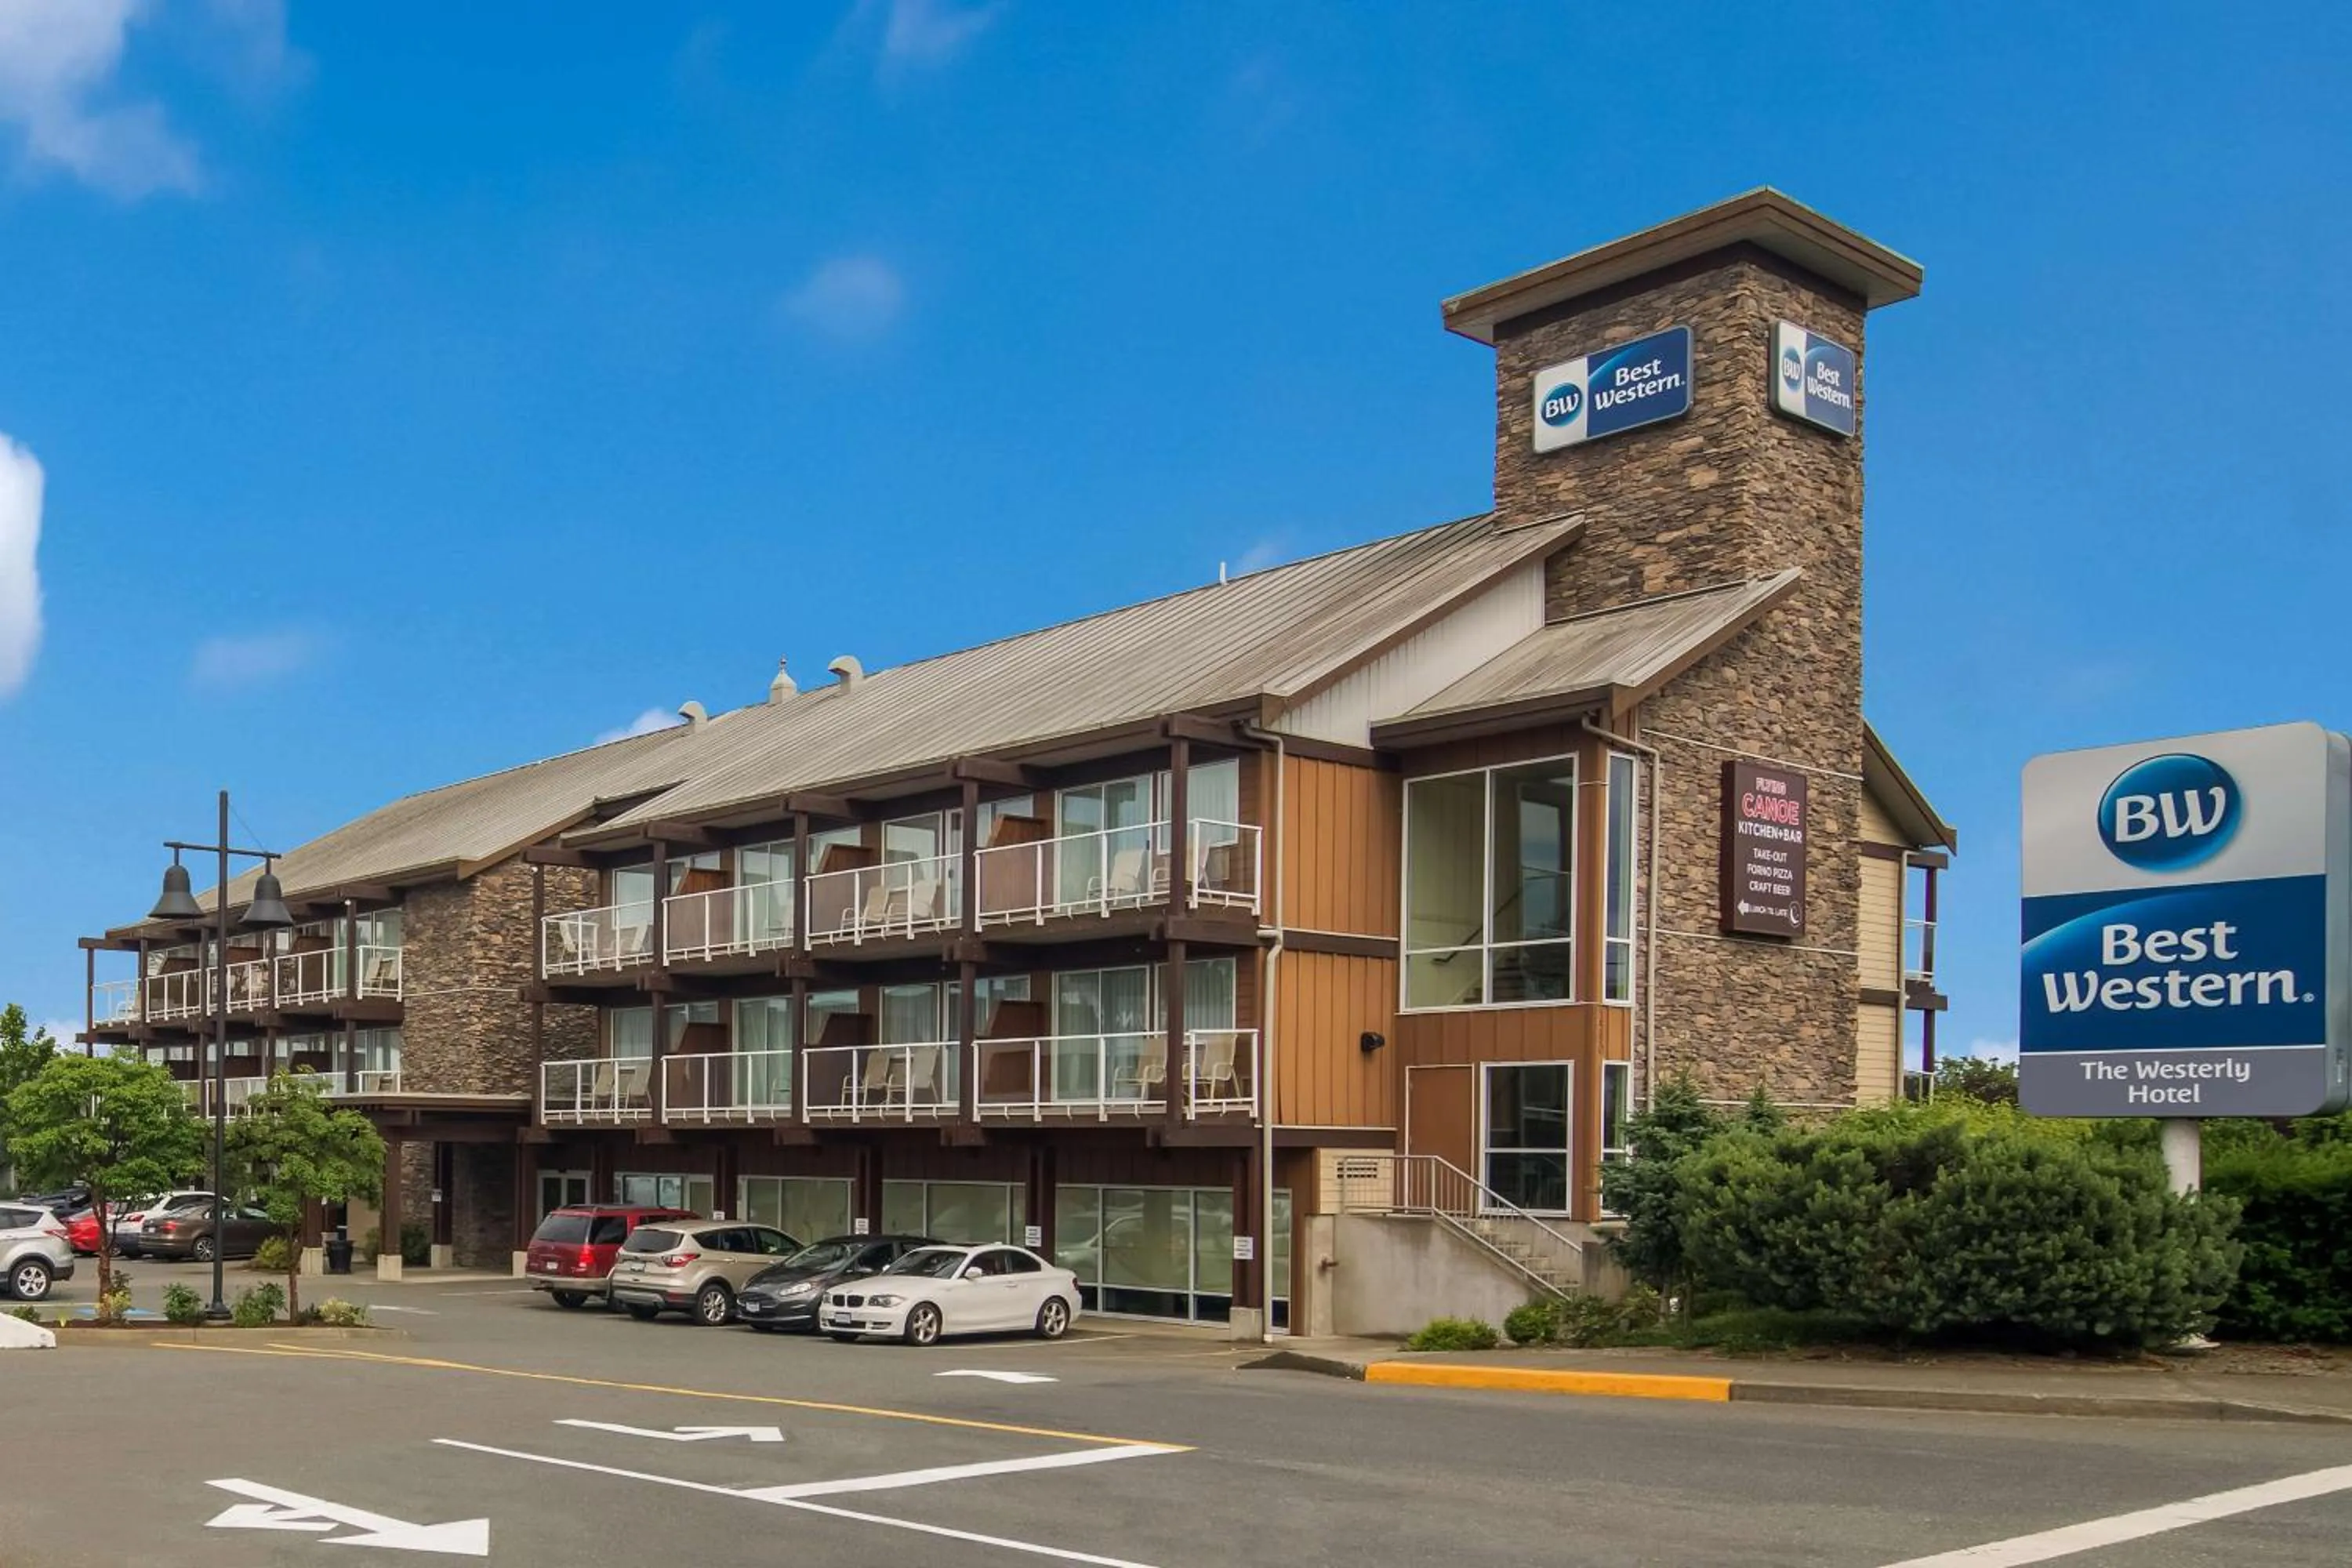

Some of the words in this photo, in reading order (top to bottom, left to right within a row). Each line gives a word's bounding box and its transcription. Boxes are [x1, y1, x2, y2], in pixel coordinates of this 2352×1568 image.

[1615, 358, 1661, 385] Best
[1784, 358, 1801, 380] BW
[1817, 361, 1840, 387] Best
[1595, 373, 1681, 410] Western
[1807, 376, 1850, 408] Western
[1545, 392, 1579, 419] BW
[1741, 793, 1800, 826] CANOE
[2116, 786, 2227, 843] BW
[1753, 848, 1788, 863] TAKE-OUT
[1749, 880, 1772, 893] CRAFT
[1773, 884, 1791, 895] BEER
[1773, 867, 1793, 881] PIZZA
[2102, 921, 2238, 966] Best
[2043, 969, 2299, 1014] Western
[2081, 1062, 2129, 1081] The
[2136, 1058, 2252, 1083] Westerly
[2128, 1083, 2201, 1103] Hotel
